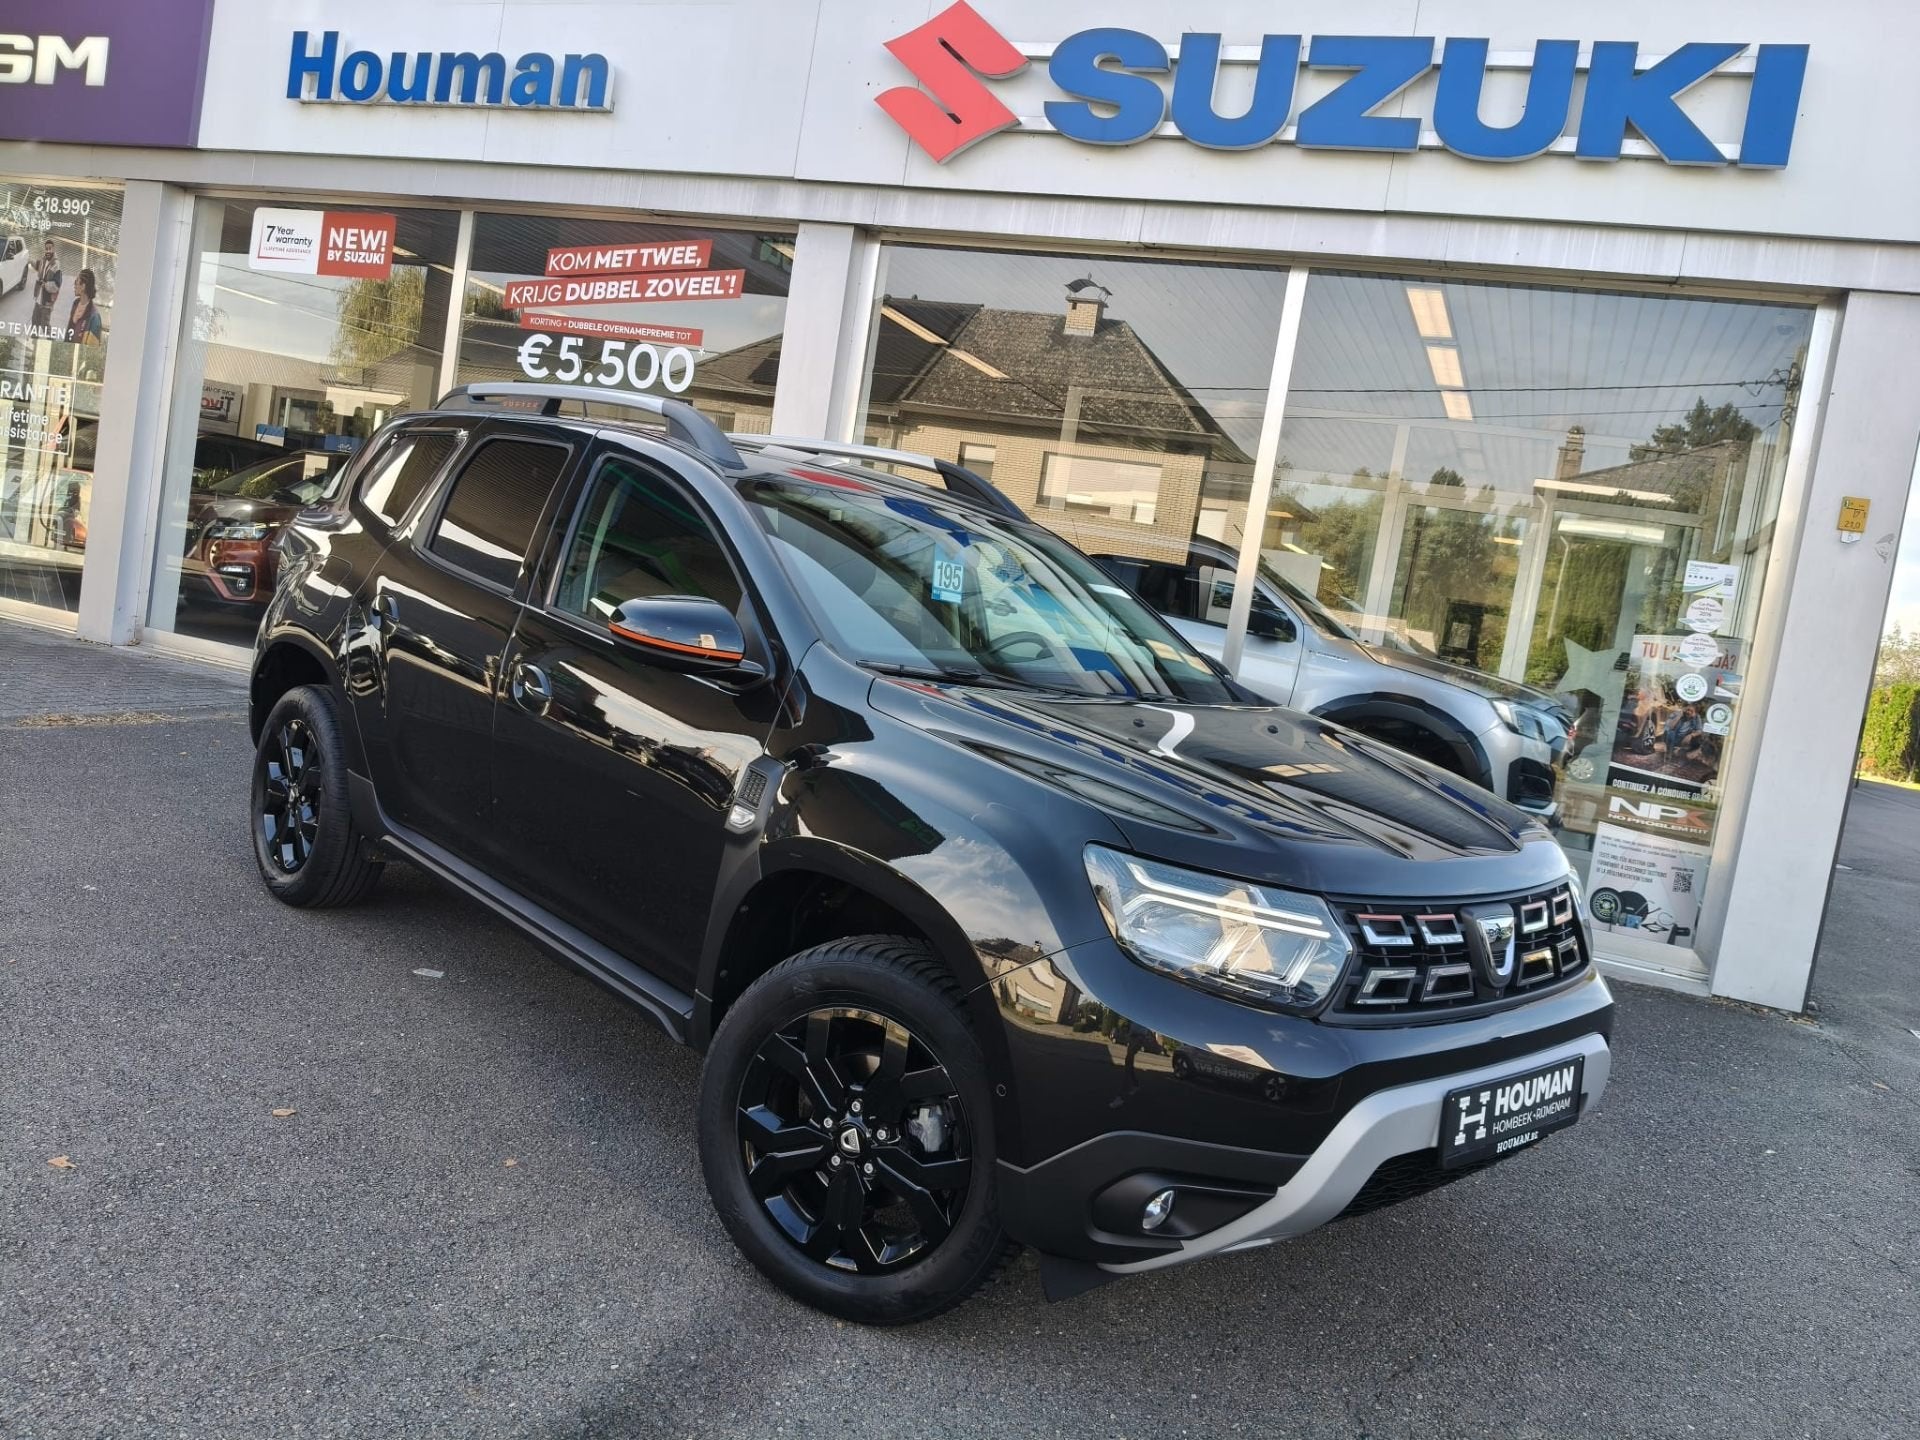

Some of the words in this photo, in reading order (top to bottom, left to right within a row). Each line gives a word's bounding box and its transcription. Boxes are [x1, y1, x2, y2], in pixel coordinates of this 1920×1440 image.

[286, 31, 610, 107] Houman
[1044, 27, 1811, 170] SUZUKI
[266, 225, 276, 243] 7
[275, 236, 313, 248] warranty
[276, 226, 295, 234] Year
[328, 227, 388, 252] NEW!
[327, 251, 341, 261] BY
[343, 251, 385, 265] SUZUKI
[549, 252, 591, 271] KOM
[594, 249, 635, 268] MET
[638, 245, 702, 267] TWEE,
[510, 284, 562, 304] KRIJG
[565, 280, 641, 300] DUBBEL
[8, 322, 21, 335] TE
[24, 323, 66, 339] VALLEN
[530, 317, 562, 328] KORTING
[568, 320, 602, 332] DUBBELE
[603, 324, 675, 340] OVERNAMEPREMIE
[676, 331, 692, 341] TOT
[936, 561, 962, 591] 195
[1642, 641, 1659, 658] TU
[1612, 778, 1650, 793] CONTINUEZ
[1608, 813, 1626, 821] NO
[1627, 817, 1688, 832] PROBLEM
[1494, 1066, 1575, 1116] HOUMAN
[1492, 1110, 1533, 1135] HOMBEEK
